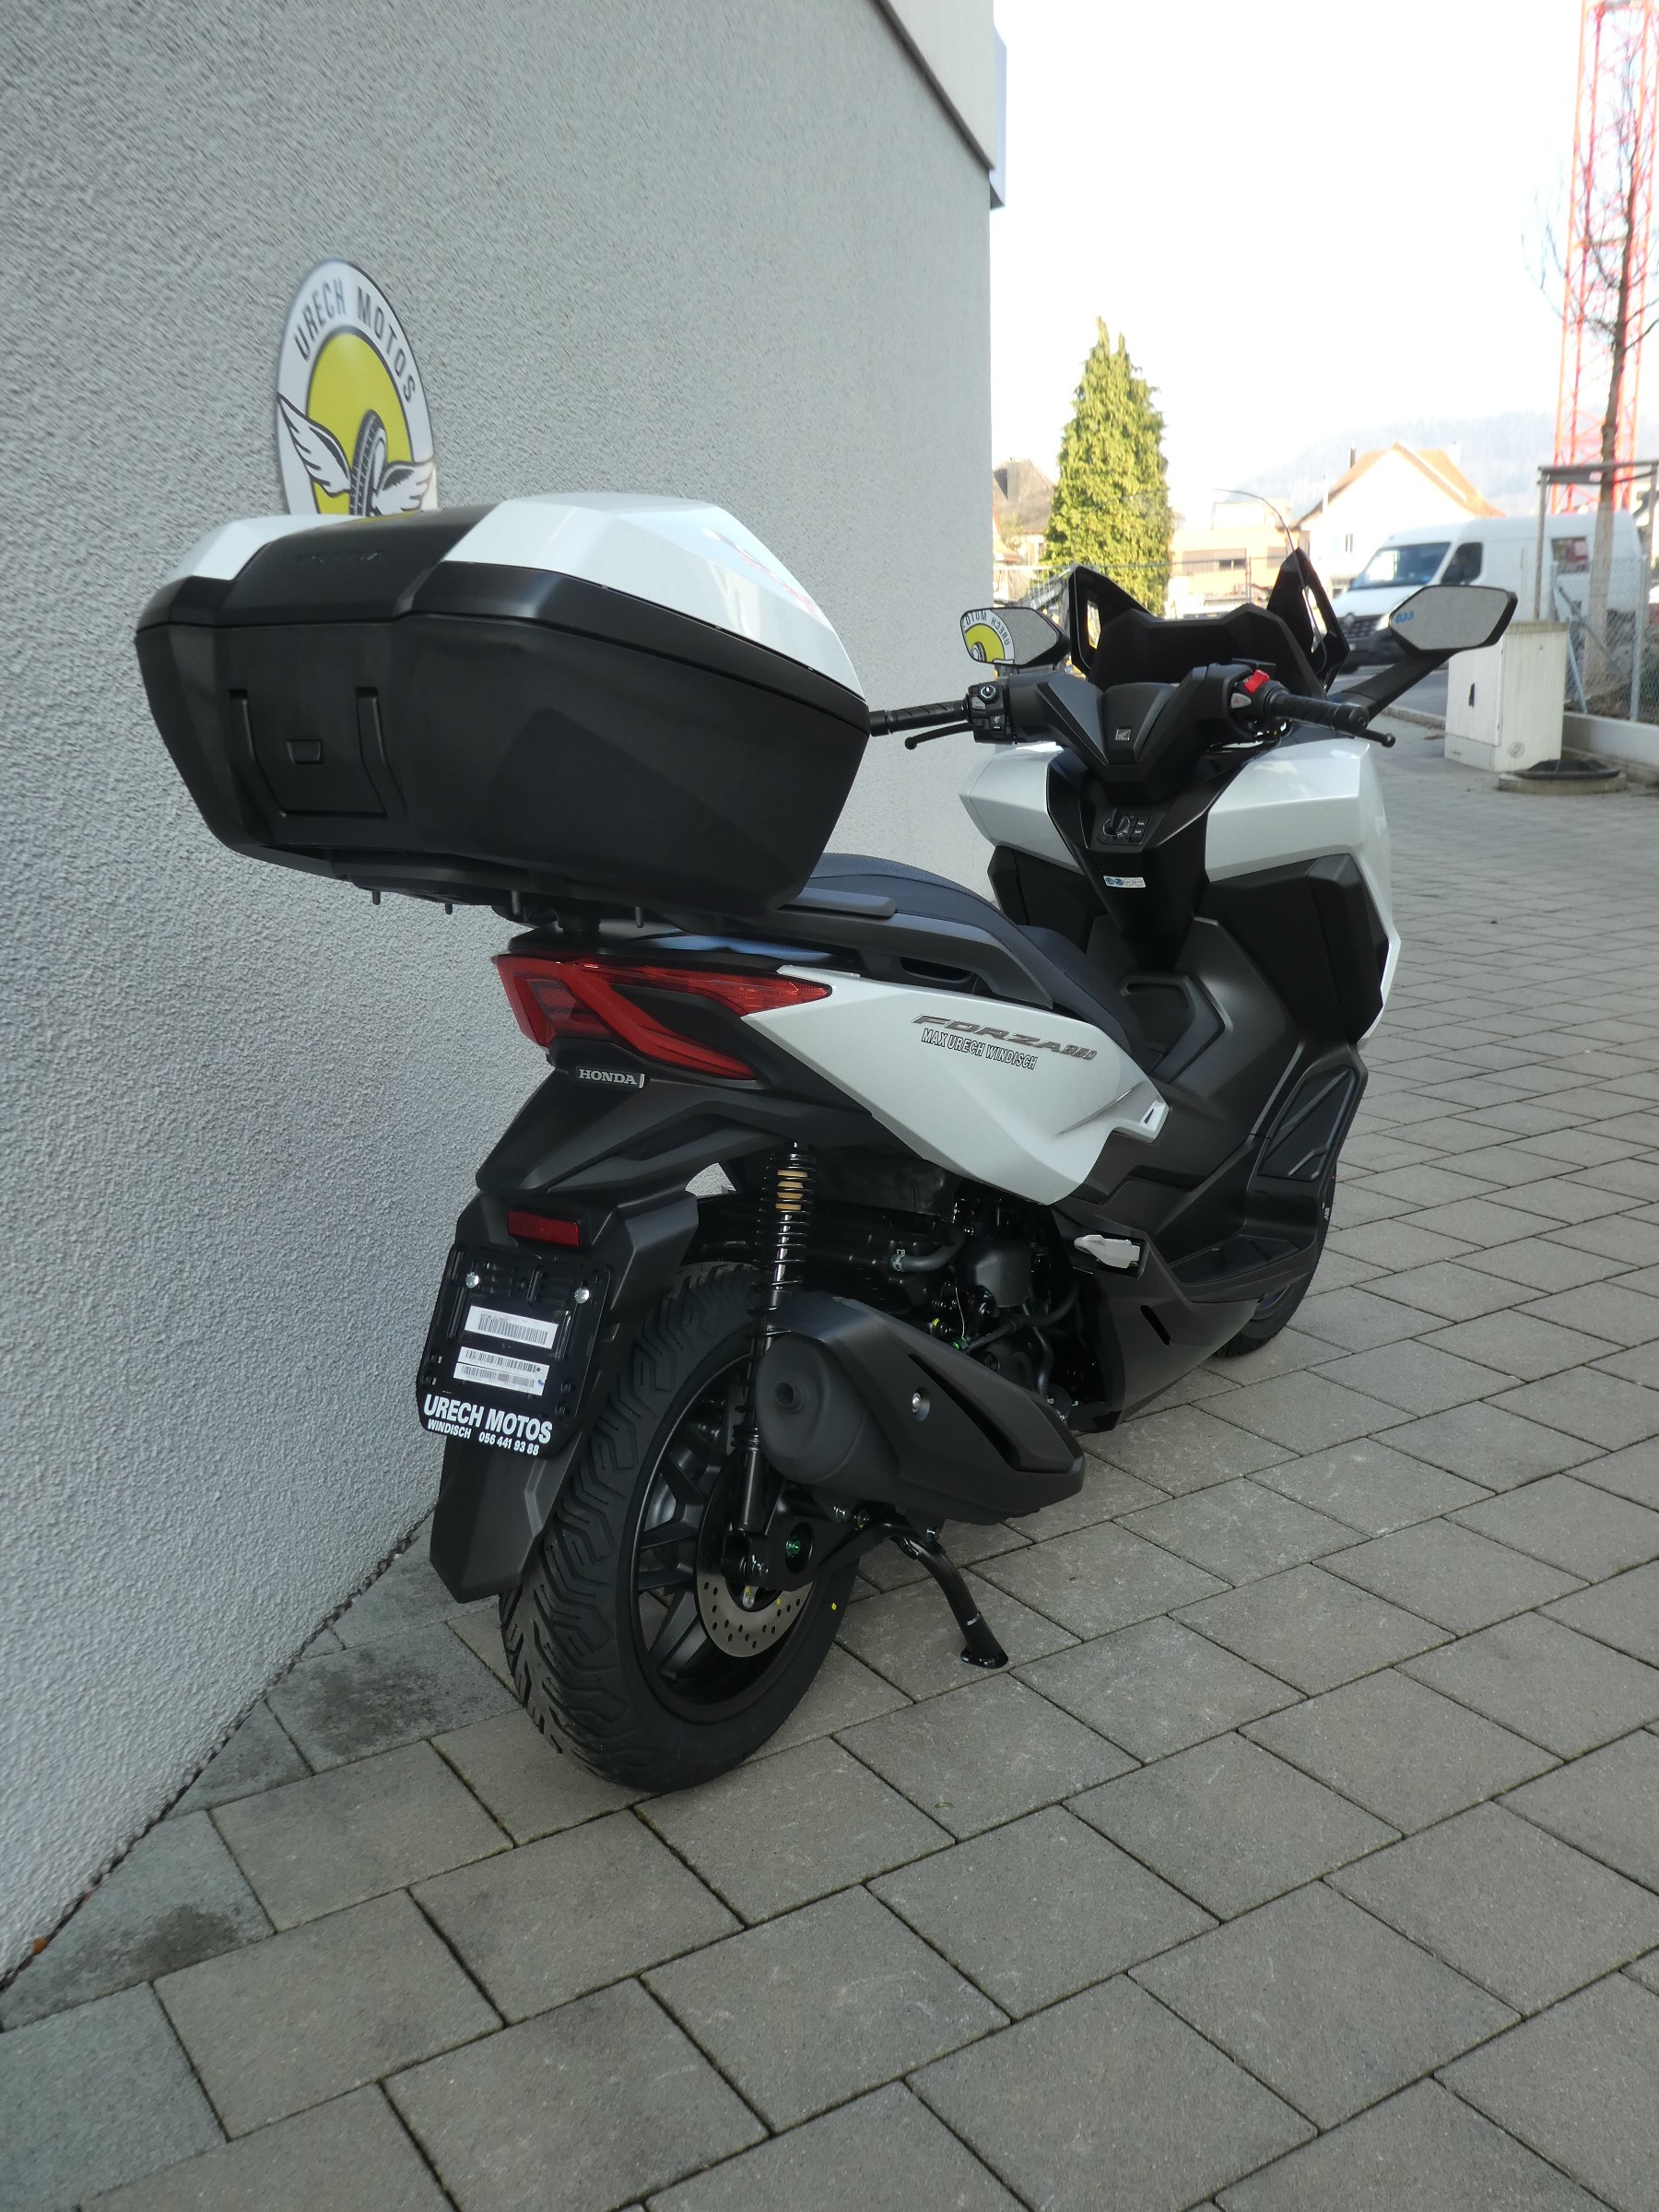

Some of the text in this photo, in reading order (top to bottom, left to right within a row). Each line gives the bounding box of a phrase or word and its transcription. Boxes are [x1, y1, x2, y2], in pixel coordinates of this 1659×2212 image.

[294, 278, 416, 403] URECH MOTOS
[911, 1014, 1063, 1053] FORZA
[921, 1028, 1039, 1070] MAX URECH WINDISCH
[578, 1068, 638, 1085] HONDA
[424, 1394, 553, 1444] URECH MOTOS
[427, 1418, 540, 1456] WINDISCH 056 441 93 88
